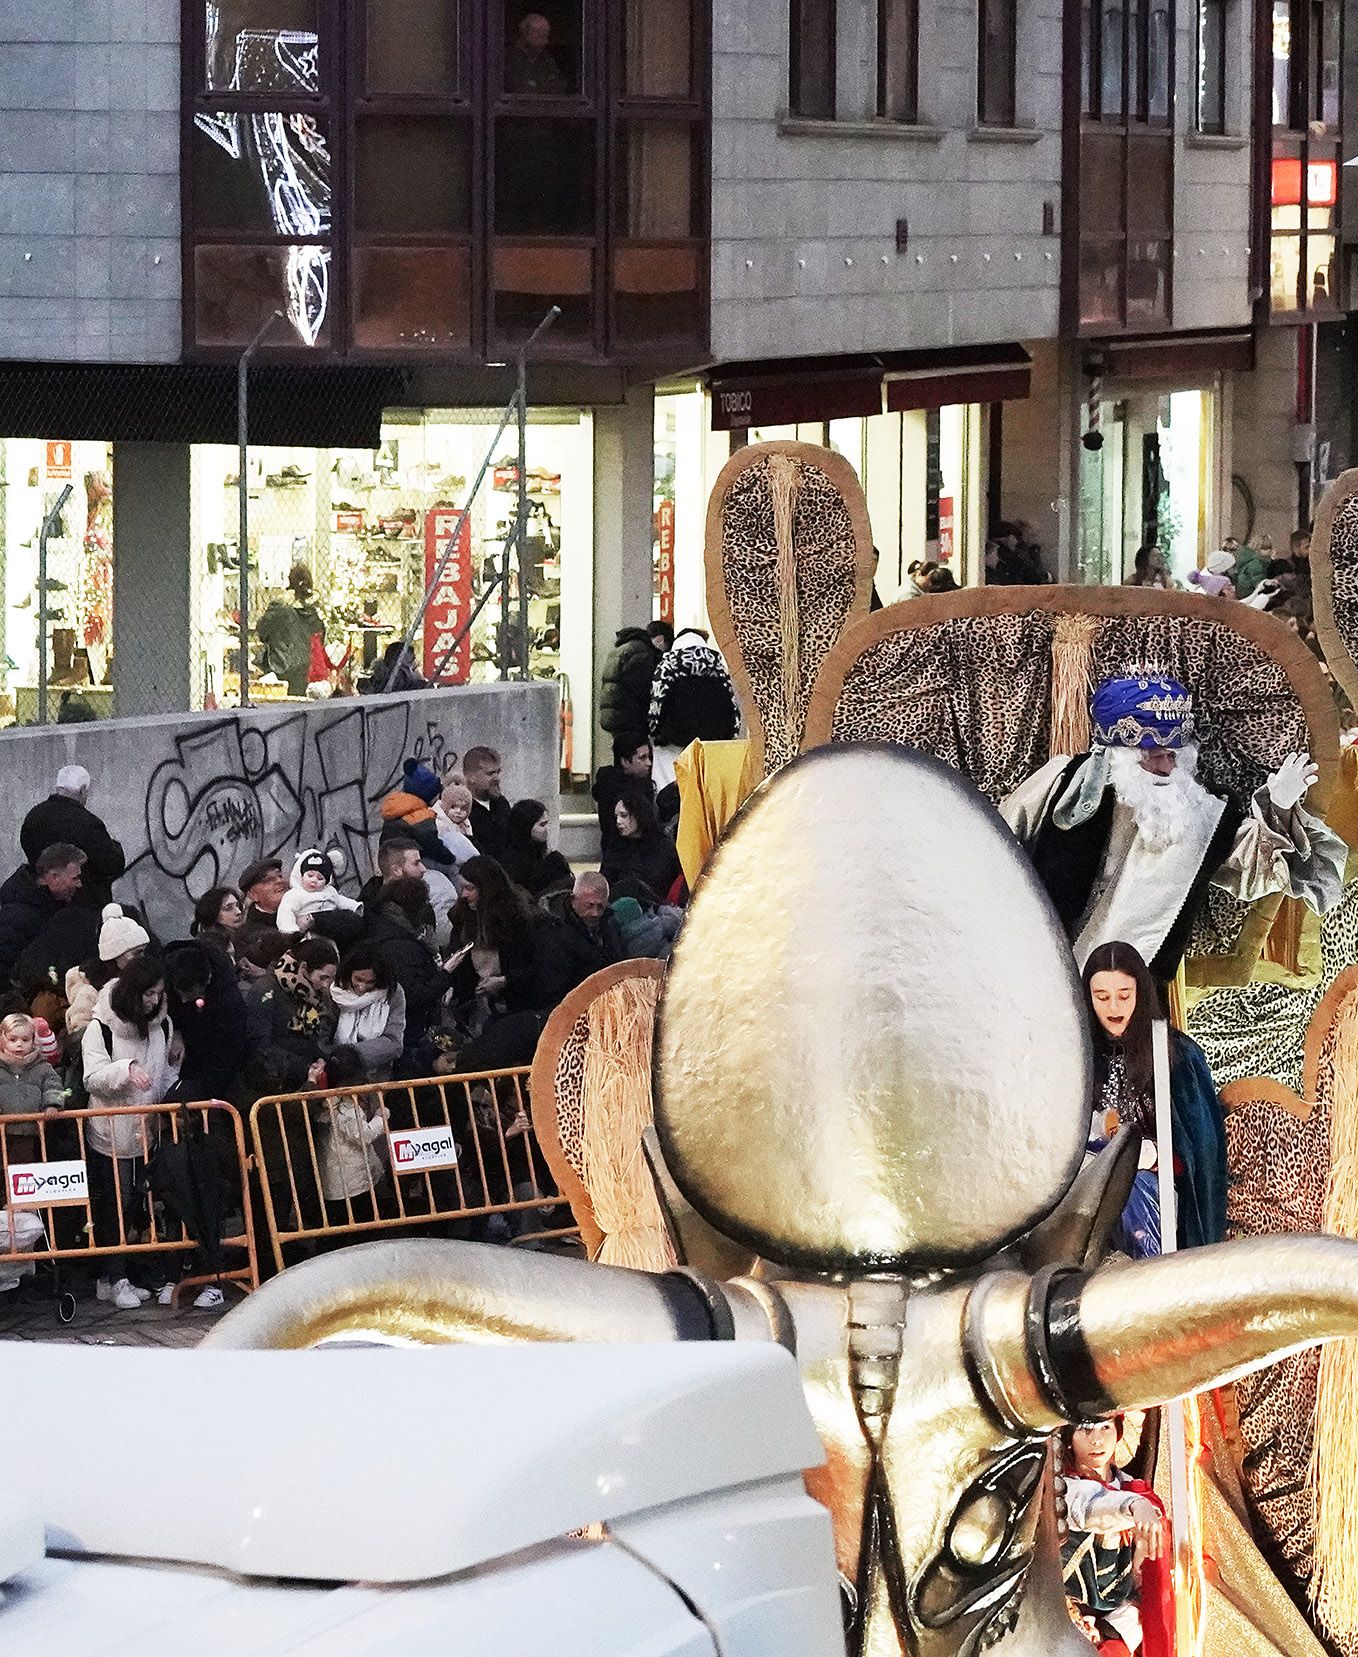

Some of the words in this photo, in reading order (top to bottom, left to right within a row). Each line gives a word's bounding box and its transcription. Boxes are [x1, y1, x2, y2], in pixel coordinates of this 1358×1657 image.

[431, 515, 462, 677] REBAJAS
[660, 507, 671, 617] REBAJ
[12, 1171, 85, 1196] Myagal
[393, 1136, 453, 1163] Myagal
